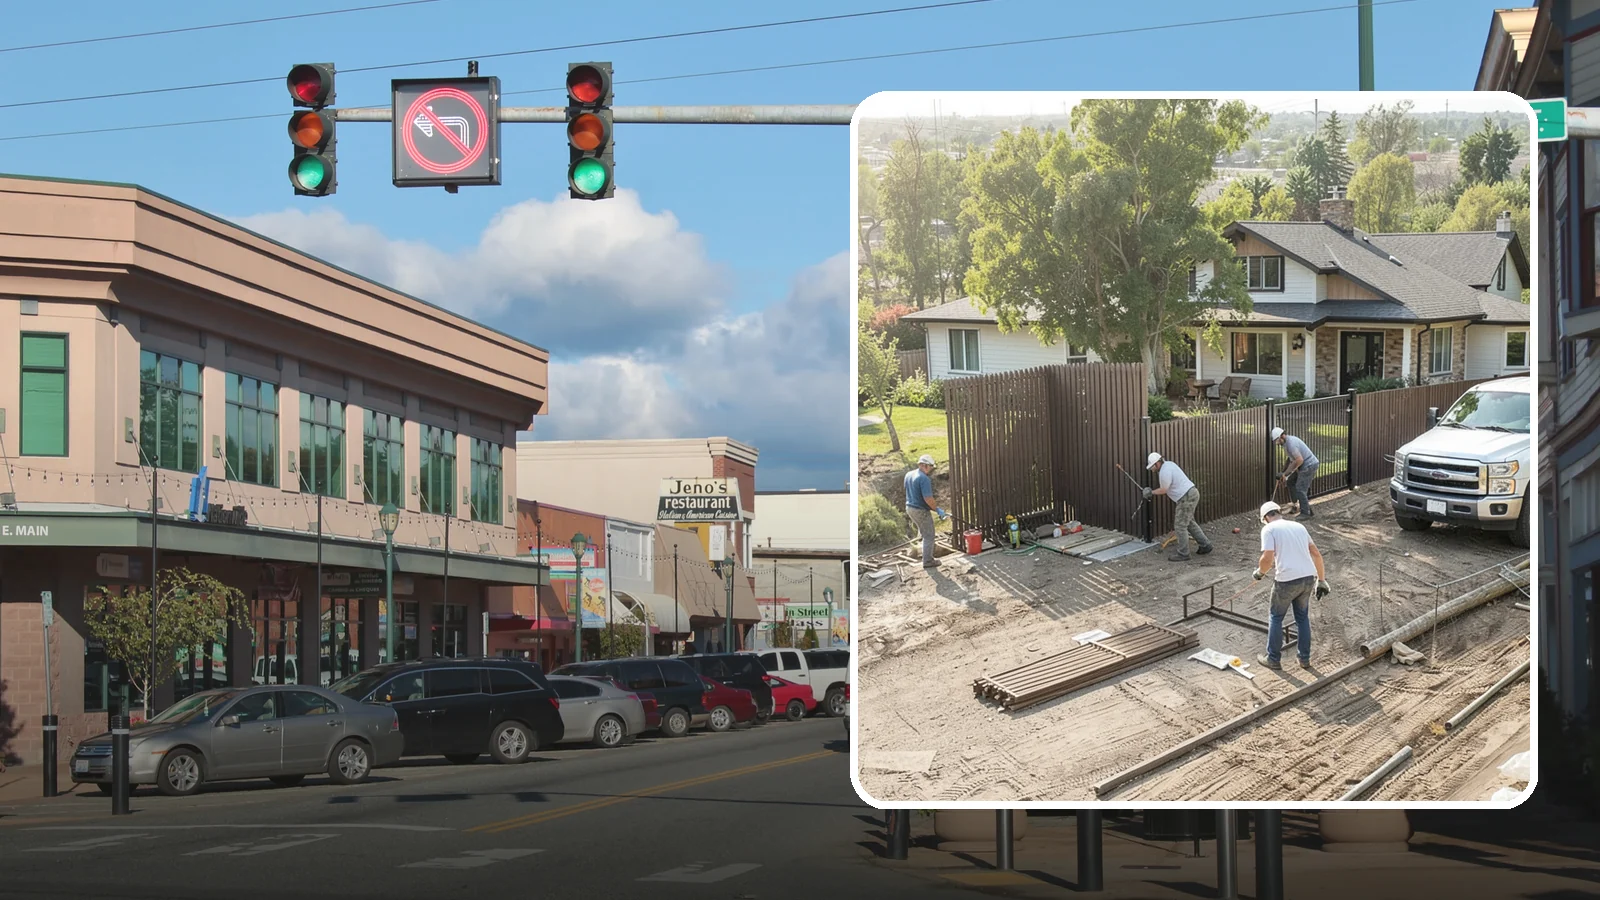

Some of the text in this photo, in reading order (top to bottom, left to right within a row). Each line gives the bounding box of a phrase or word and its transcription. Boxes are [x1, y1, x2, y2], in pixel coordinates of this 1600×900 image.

[670, 480, 727, 494] Jeno's
[665, 496, 731, 509] restaurant
[658, 509, 681, 520] Italian
[686, 509, 714, 519] American
[715, 509, 738, 519] Cuisine
[2, 525, 49, 536] E. MAIN
[797, 607, 828, 617] Street
